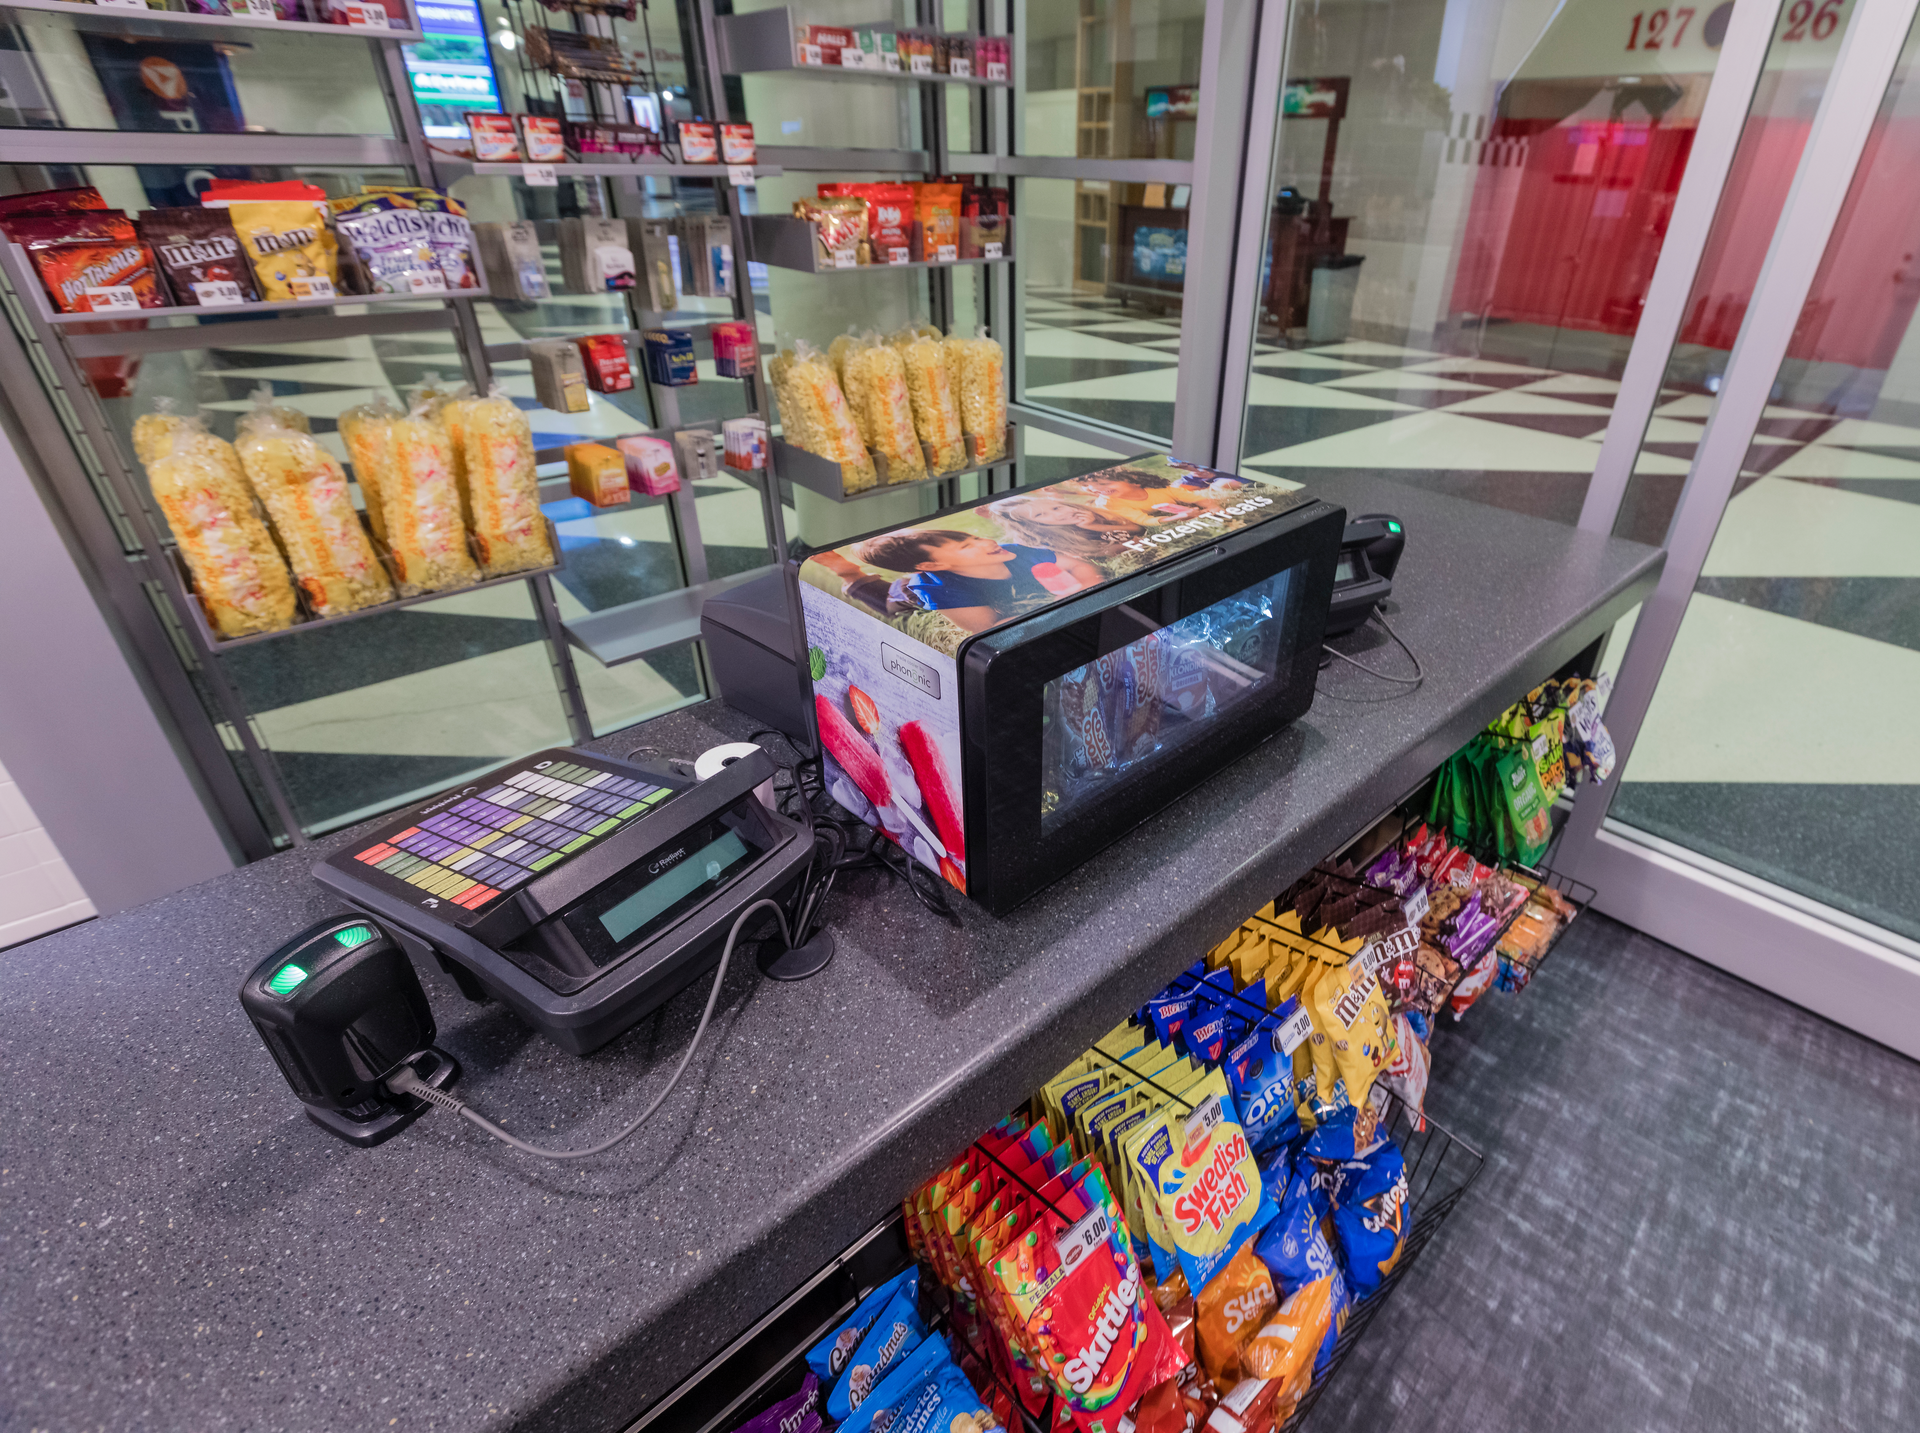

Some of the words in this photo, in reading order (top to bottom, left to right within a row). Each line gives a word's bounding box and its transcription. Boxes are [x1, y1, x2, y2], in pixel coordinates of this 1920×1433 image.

[817, 33, 847, 46] HALLS
[1626, 8, 1695, 51] 127
[346, 212, 421, 243] Welch's
[61, 276, 88, 303] HOT
[83, 246, 141, 287] TAMALES
[1123, 517, 1205, 552] Frozen
[1200, 494, 1273, 528] Treats
[890, 659, 931, 689] phononic
[1132, 643, 1147, 695] TACO
[1540, 746, 1562, 773] SOUR
[462, 830, 487, 843] $20
[492, 814, 517, 827] $10
[659, 847, 684, 867] Radiant
[467, 885, 484, 895] LOG
[476, 892, 493, 902] LOG
[1159, 1004, 1178, 1019] BIG
[1193, 1024, 1214, 1043] BIG
[1245, 1071, 1294, 1126] ORE
[1264, 1081, 1294, 1124] min
[1174, 1132, 1249, 1234] Swedish
[1203, 1168, 1249, 1233] Fish
[1029, 1267, 1066, 1304] RESEALA
[1224, 1282, 1276, 1334] Sun
[1063, 1261, 1140, 1393] Skittles
[848, 1322, 908, 1410] Grandma's
